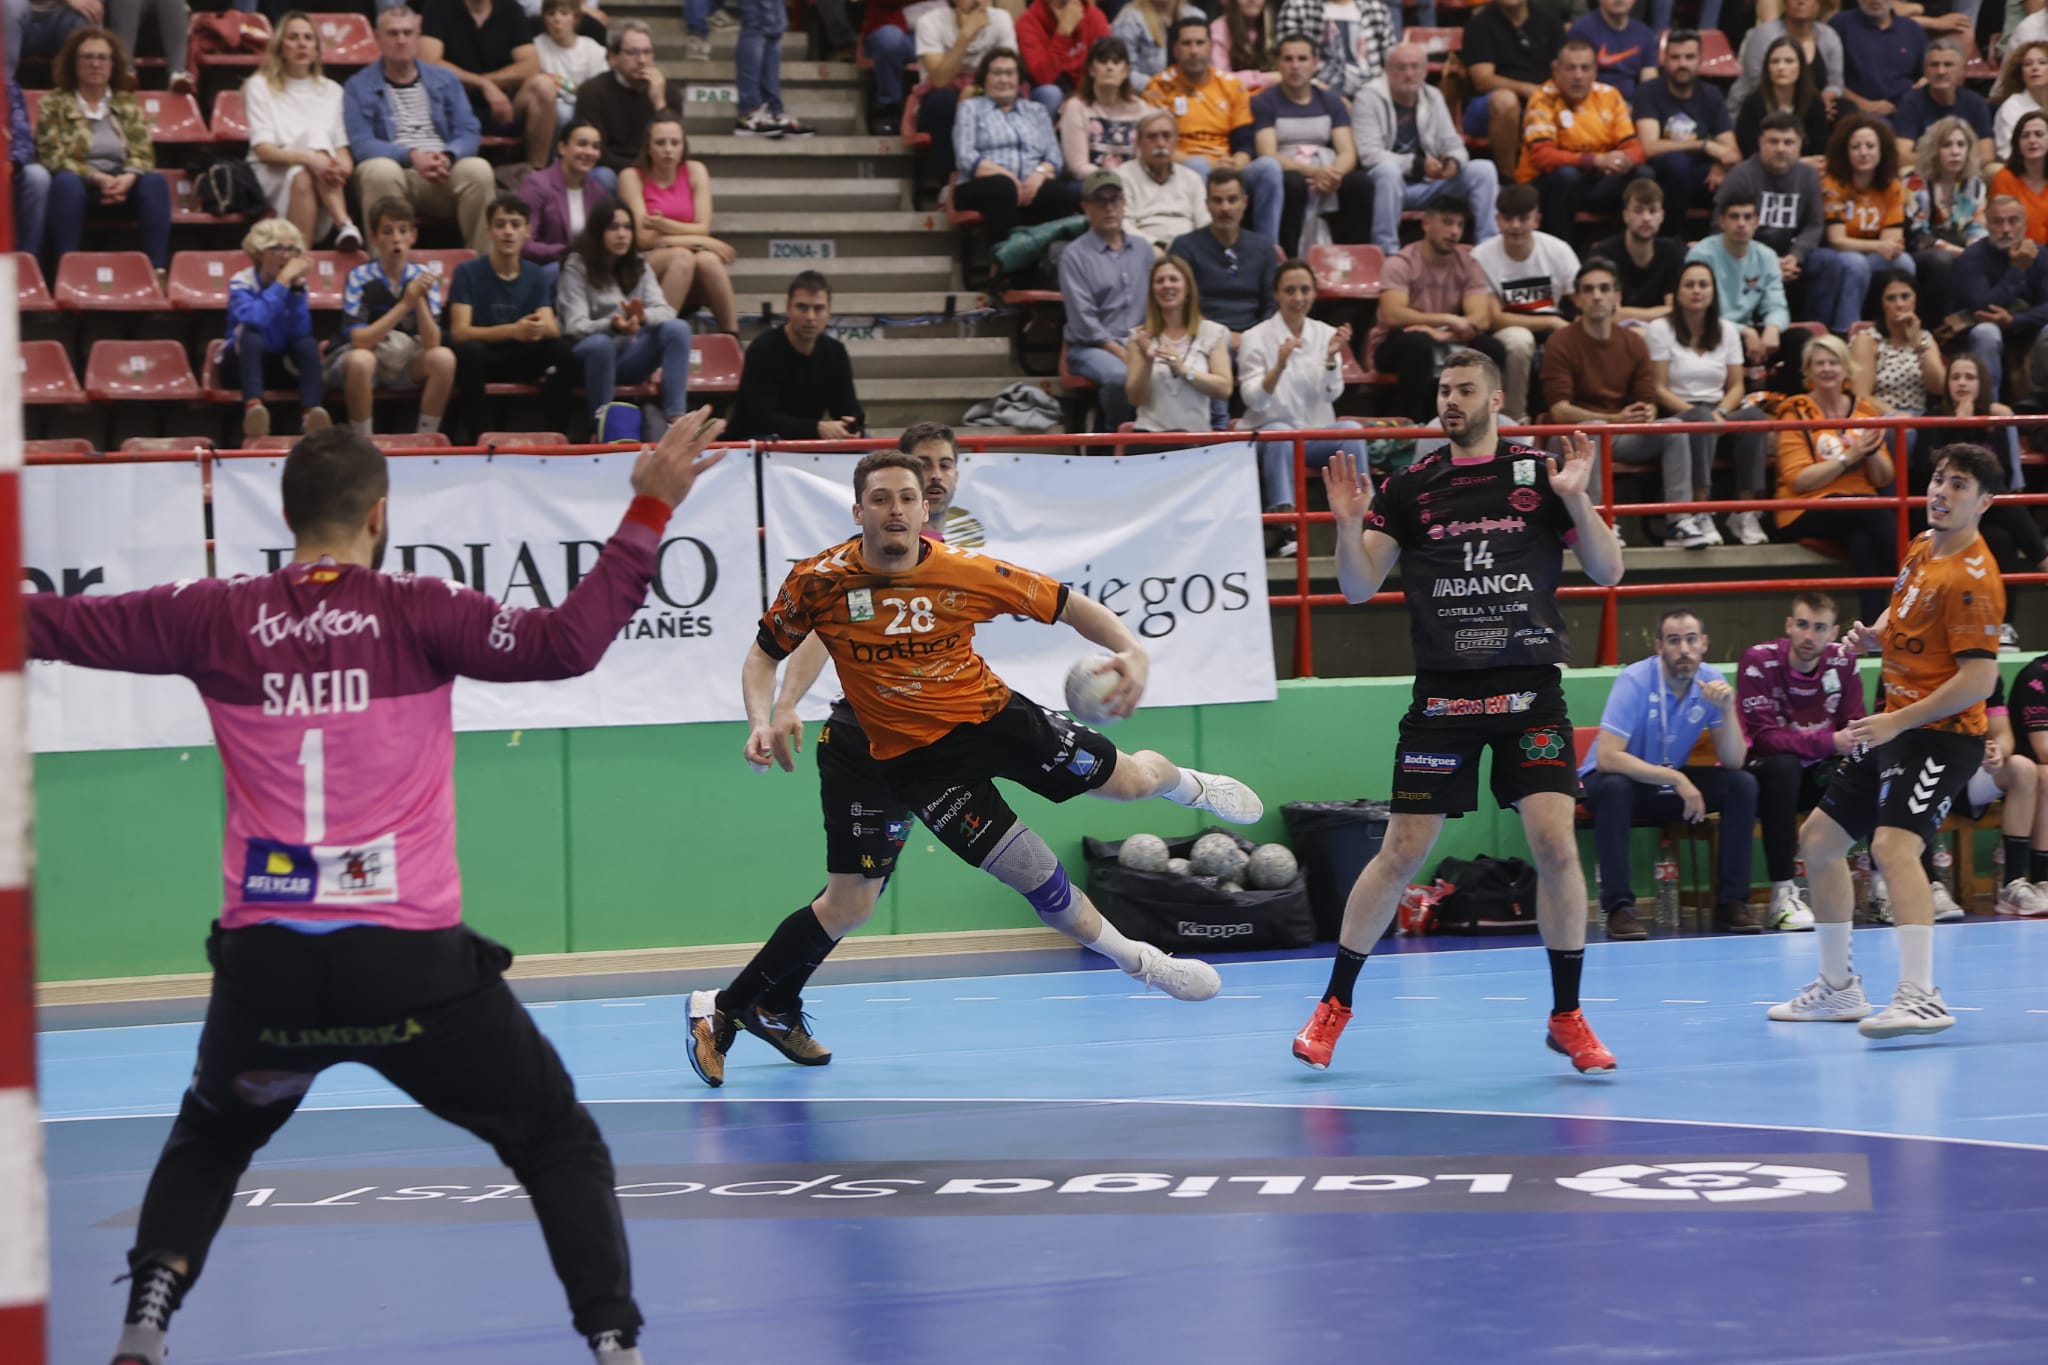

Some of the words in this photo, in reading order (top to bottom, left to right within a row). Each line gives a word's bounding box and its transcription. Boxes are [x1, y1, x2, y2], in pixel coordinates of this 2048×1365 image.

[695, 88, 731, 101] PAR
[1858, 207, 1880, 231] 12
[1463, 541, 1494, 572] 14
[882, 597, 936, 635] 28
[1437, 607, 1486, 617] CASTILLA
[1499, 601, 1529, 613] LEÓN
[262, 668, 369, 716] SAEID
[1404, 754, 1457, 767] Rodríguez
[297, 728, 326, 843] 1
[1178, 921, 1253, 938] Kappa
